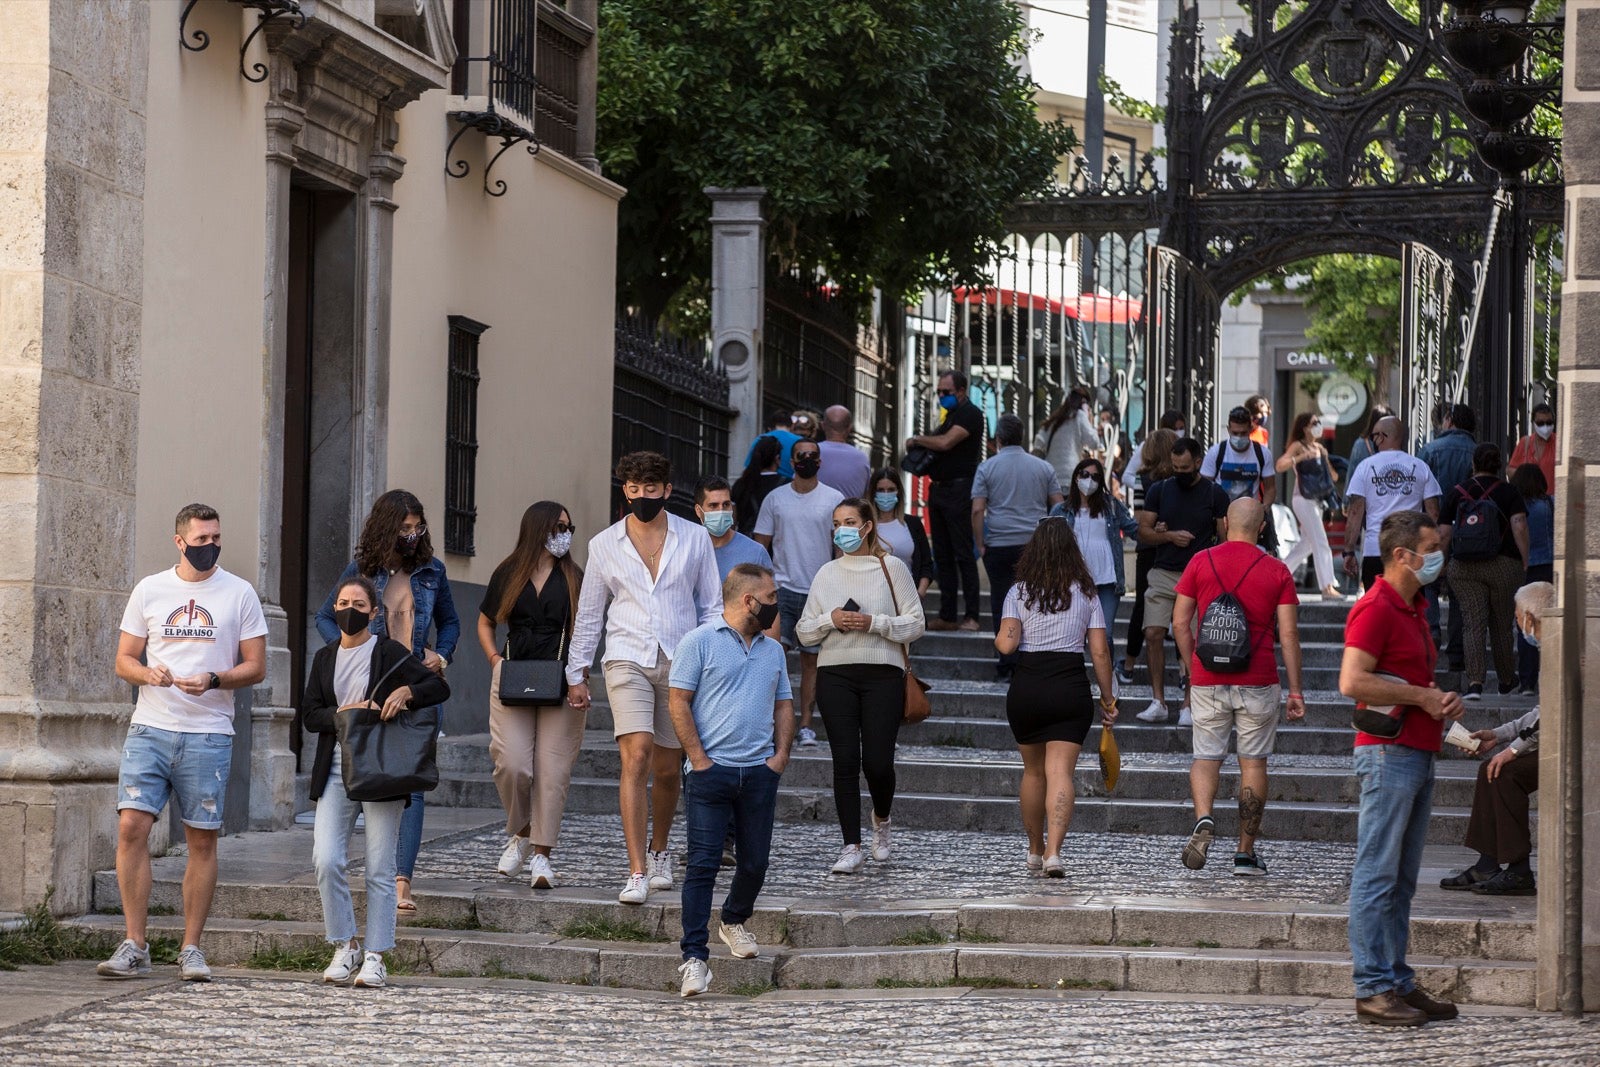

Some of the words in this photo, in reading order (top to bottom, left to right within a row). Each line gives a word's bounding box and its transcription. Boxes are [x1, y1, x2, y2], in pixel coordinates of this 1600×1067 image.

[1211, 616, 1239, 628] YOUR
[164, 628, 174, 636] EL
[176, 628, 213, 637] PARAISO
[1209, 629, 1238, 641] MIND
